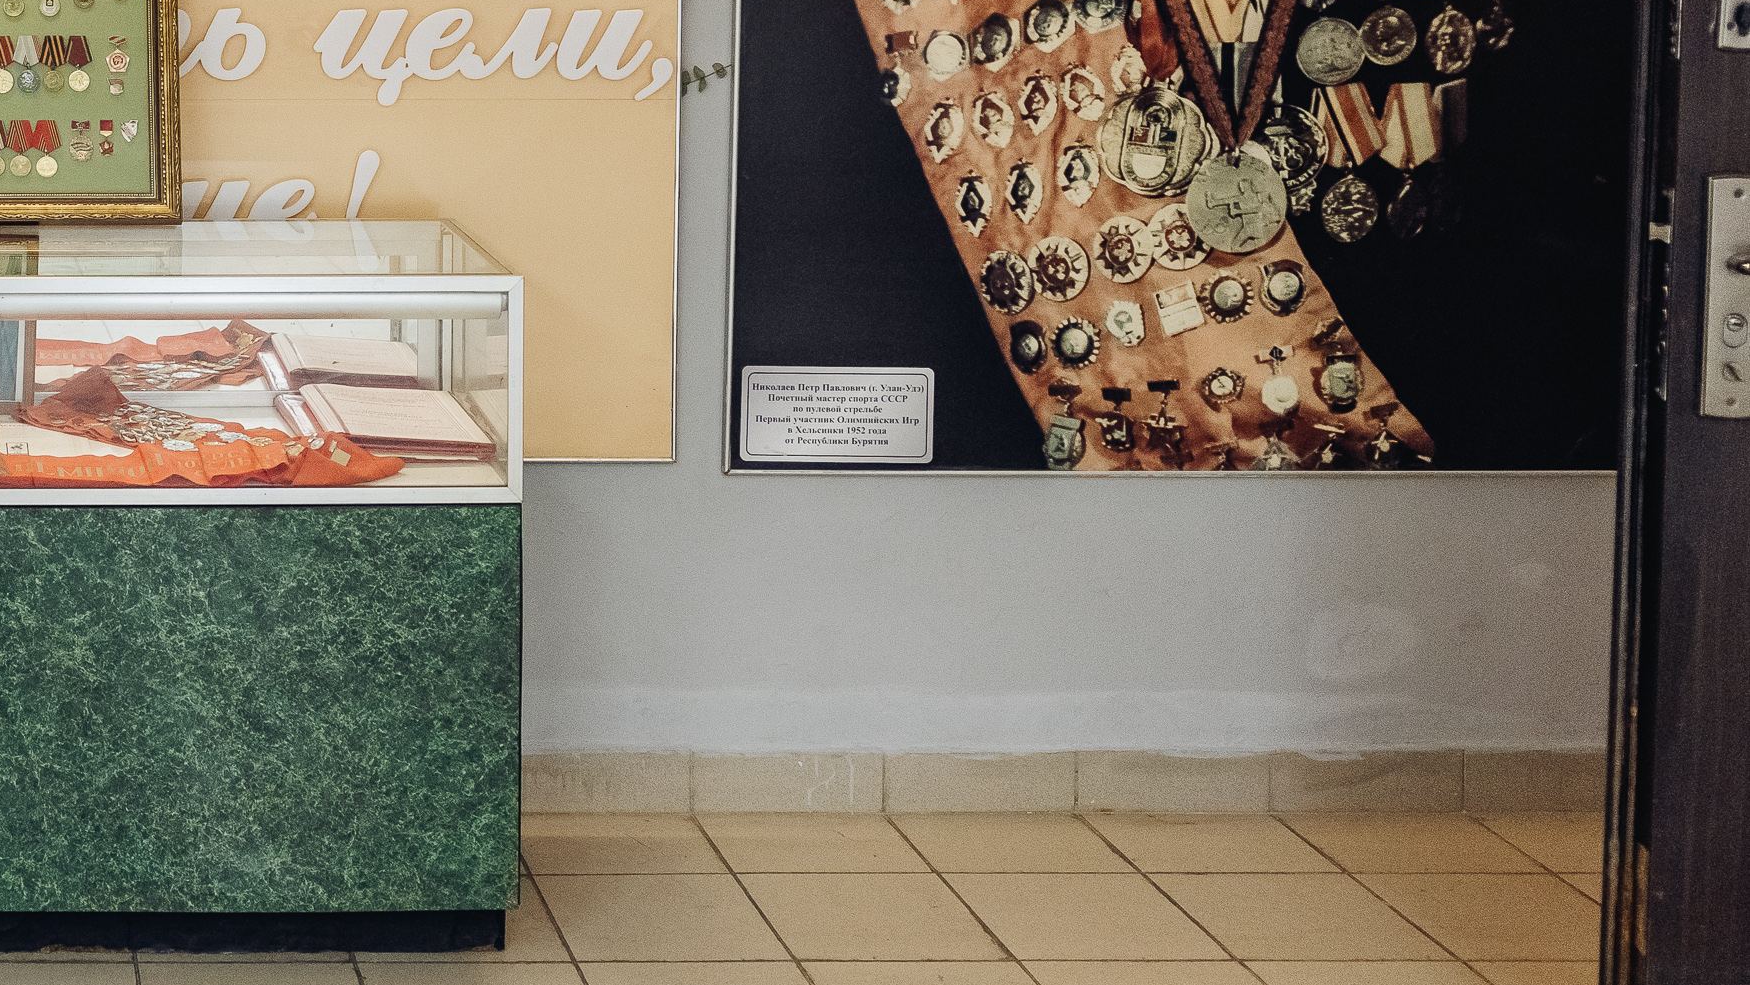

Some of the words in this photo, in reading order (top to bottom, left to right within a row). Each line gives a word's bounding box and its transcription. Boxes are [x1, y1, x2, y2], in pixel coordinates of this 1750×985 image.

[313, 7, 674, 106] цели,
[752, 382, 796, 391] Николаев
[798, 383, 820, 393] Петр
[822, 383, 867, 392] Павлович
[880, 384, 925, 394] Улан-Удэ)
[768, 393, 814, 402] Почетный
[815, 395, 847, 404] мастер
[848, 396, 879, 404] спорта
[880, 395, 908, 403] СССР
[805, 405, 841, 414] пулевой
[843, 406, 883, 415] стрельбе
[755, 415, 791, 424] Первый
[837, 416, 900, 424] Олимпийских
[902, 417, 920, 426] Игр
[795, 426, 844, 434] Хельсинки
[846, 426, 866, 434] 1952
[797, 436, 849, 445] Республики
[851, 437, 889, 447] Бурятия
